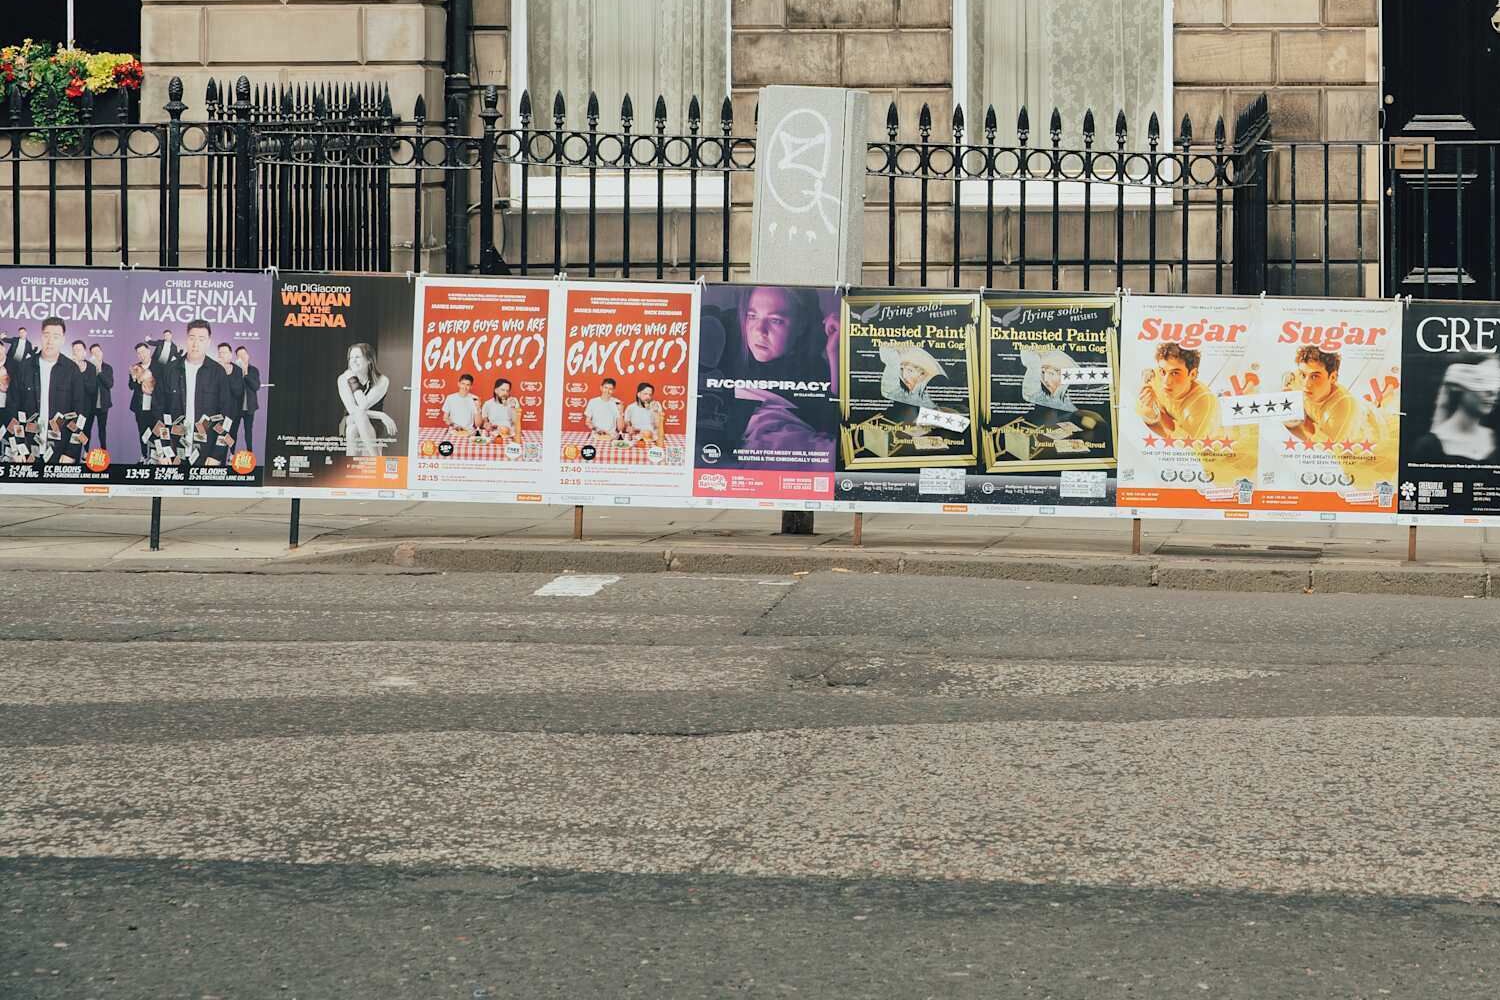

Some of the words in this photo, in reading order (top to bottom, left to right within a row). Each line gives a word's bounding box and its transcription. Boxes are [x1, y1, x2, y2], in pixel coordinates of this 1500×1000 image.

[21, 277, 46, 285] CHRIS
[49, 277, 89, 286] FLEMING
[166, 279, 191, 288] CHRIS
[194, 280, 234, 289] FLEMING
[281, 283, 298, 292] Jen
[300, 284, 351, 293] DiGiacomo
[0, 285, 112, 303] MILLENNIAL
[142, 288, 257, 306] MILLENNIAL
[281, 292, 351, 306] WOMAN
[0, 302, 110, 321] MAGICIAN
[139, 304, 256, 324] MAGICIAN
[313, 306, 331, 314] THE
[879, 306, 914, 321] flying
[929, 308, 957, 319] PRESENTS
[1020, 309, 1054, 325] flying
[1070, 312, 1098, 322] PRESENTS
[284, 312, 347, 328] ARENA
[427, 321, 436, 334] 2
[439, 320, 471, 334] WEIRD
[473, 320, 500, 333] GUYS
[501, 318, 525, 332] WHO
[526, 318, 547, 333] ARE
[569, 325, 578, 338] 2
[581, 324, 613, 338] WEIRD
[615, 323, 641, 337] GUYS
[644, 322, 667, 336] WHO
[669, 321, 688, 337] ARE
[849, 323, 922, 338] Exhausted
[991, 327, 1062, 341] Exhausted
[1137, 318, 1248, 348] Sugar
[1278, 320, 1387, 351] Sugar
[928, 340, 946, 349] Van
[1069, 343, 1087, 352] Van
[706, 379, 831, 391] R/CONSPIRACY
[54, 465, 82, 473] BLOOMS
[125, 468, 151, 479] 13:45
[189, 467, 199, 475] CC
[200, 467, 228, 476] BLOOMS
